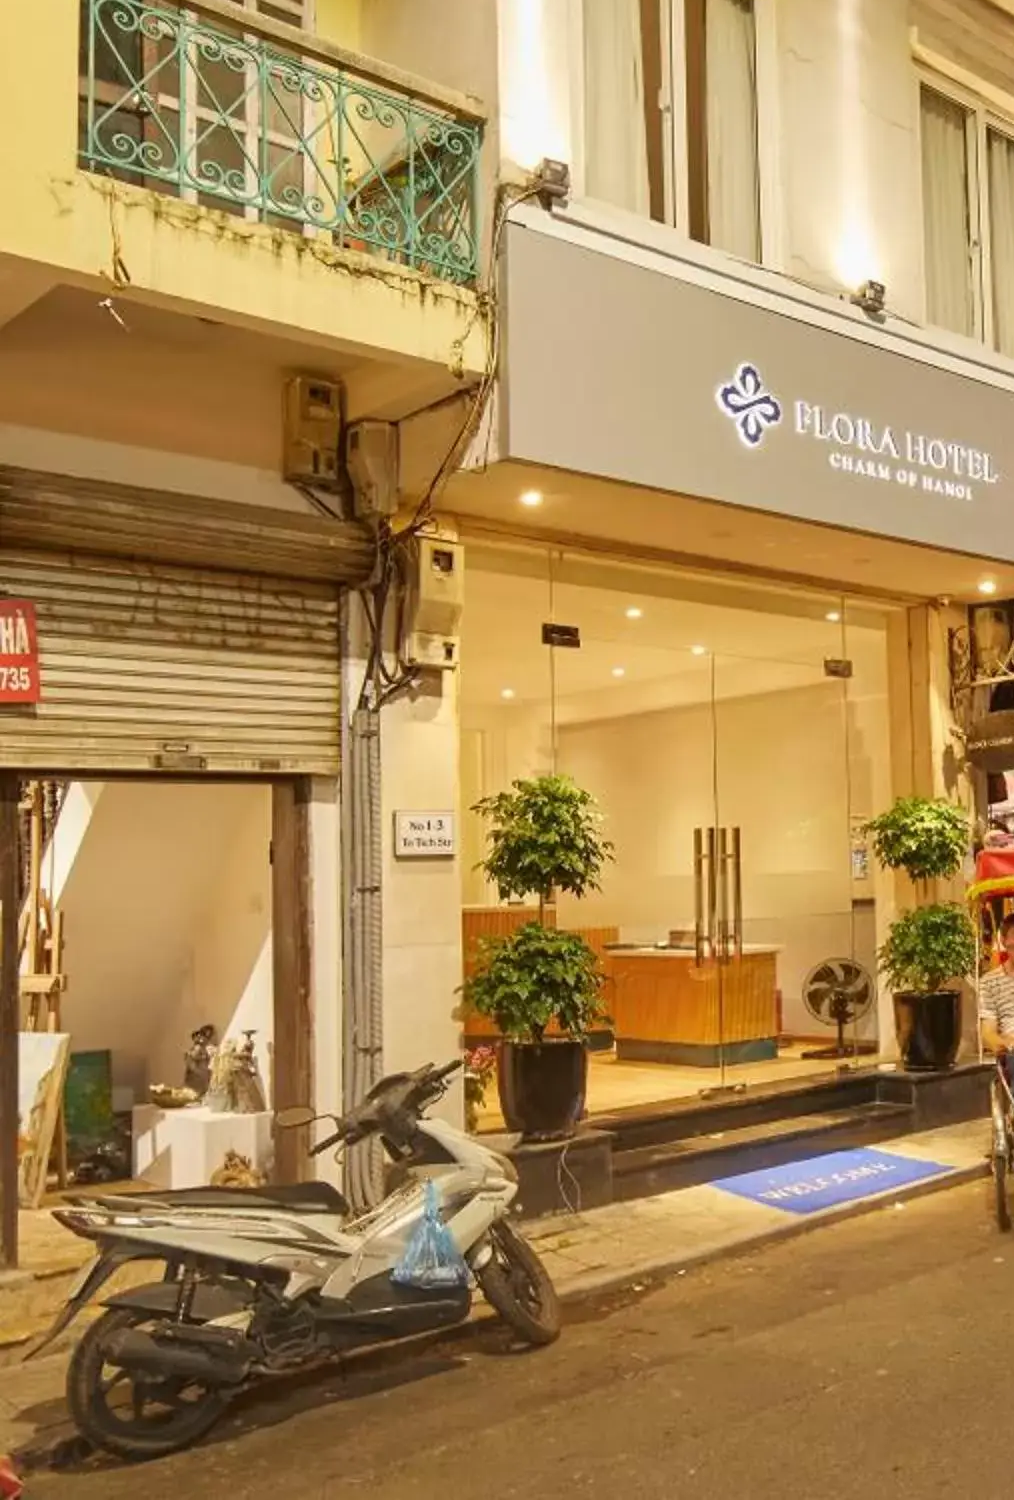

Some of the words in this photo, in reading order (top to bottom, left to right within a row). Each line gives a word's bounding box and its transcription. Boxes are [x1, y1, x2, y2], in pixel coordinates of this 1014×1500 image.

[794, 399, 900, 460] FLORA
[905, 431, 999, 484] HOTEL
[828, 452, 891, 481] CHARM
[896, 469, 918, 488] OF
[922, 475, 973, 501] HANOI
[0, 608, 30, 655] HÀ
